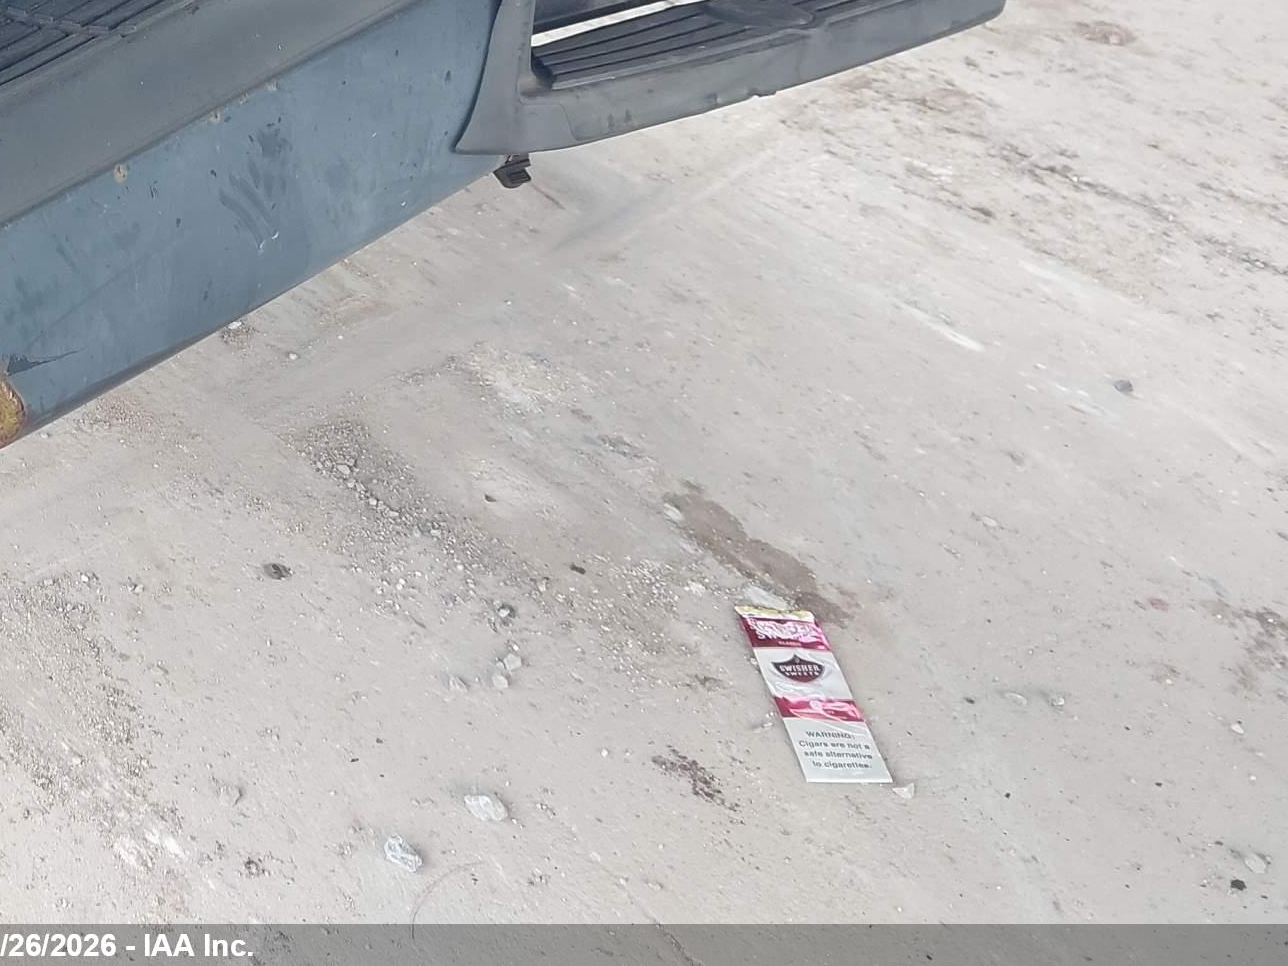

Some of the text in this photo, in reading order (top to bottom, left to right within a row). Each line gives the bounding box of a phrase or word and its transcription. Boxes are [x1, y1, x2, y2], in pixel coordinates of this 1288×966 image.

[779, 664, 820, 672] SWISHER
[799, 740, 828, 748] Cigars
[847, 742, 862, 750] not
[825, 750, 872, 759] alternative
[824, 761, 872, 769] cigarettes.
